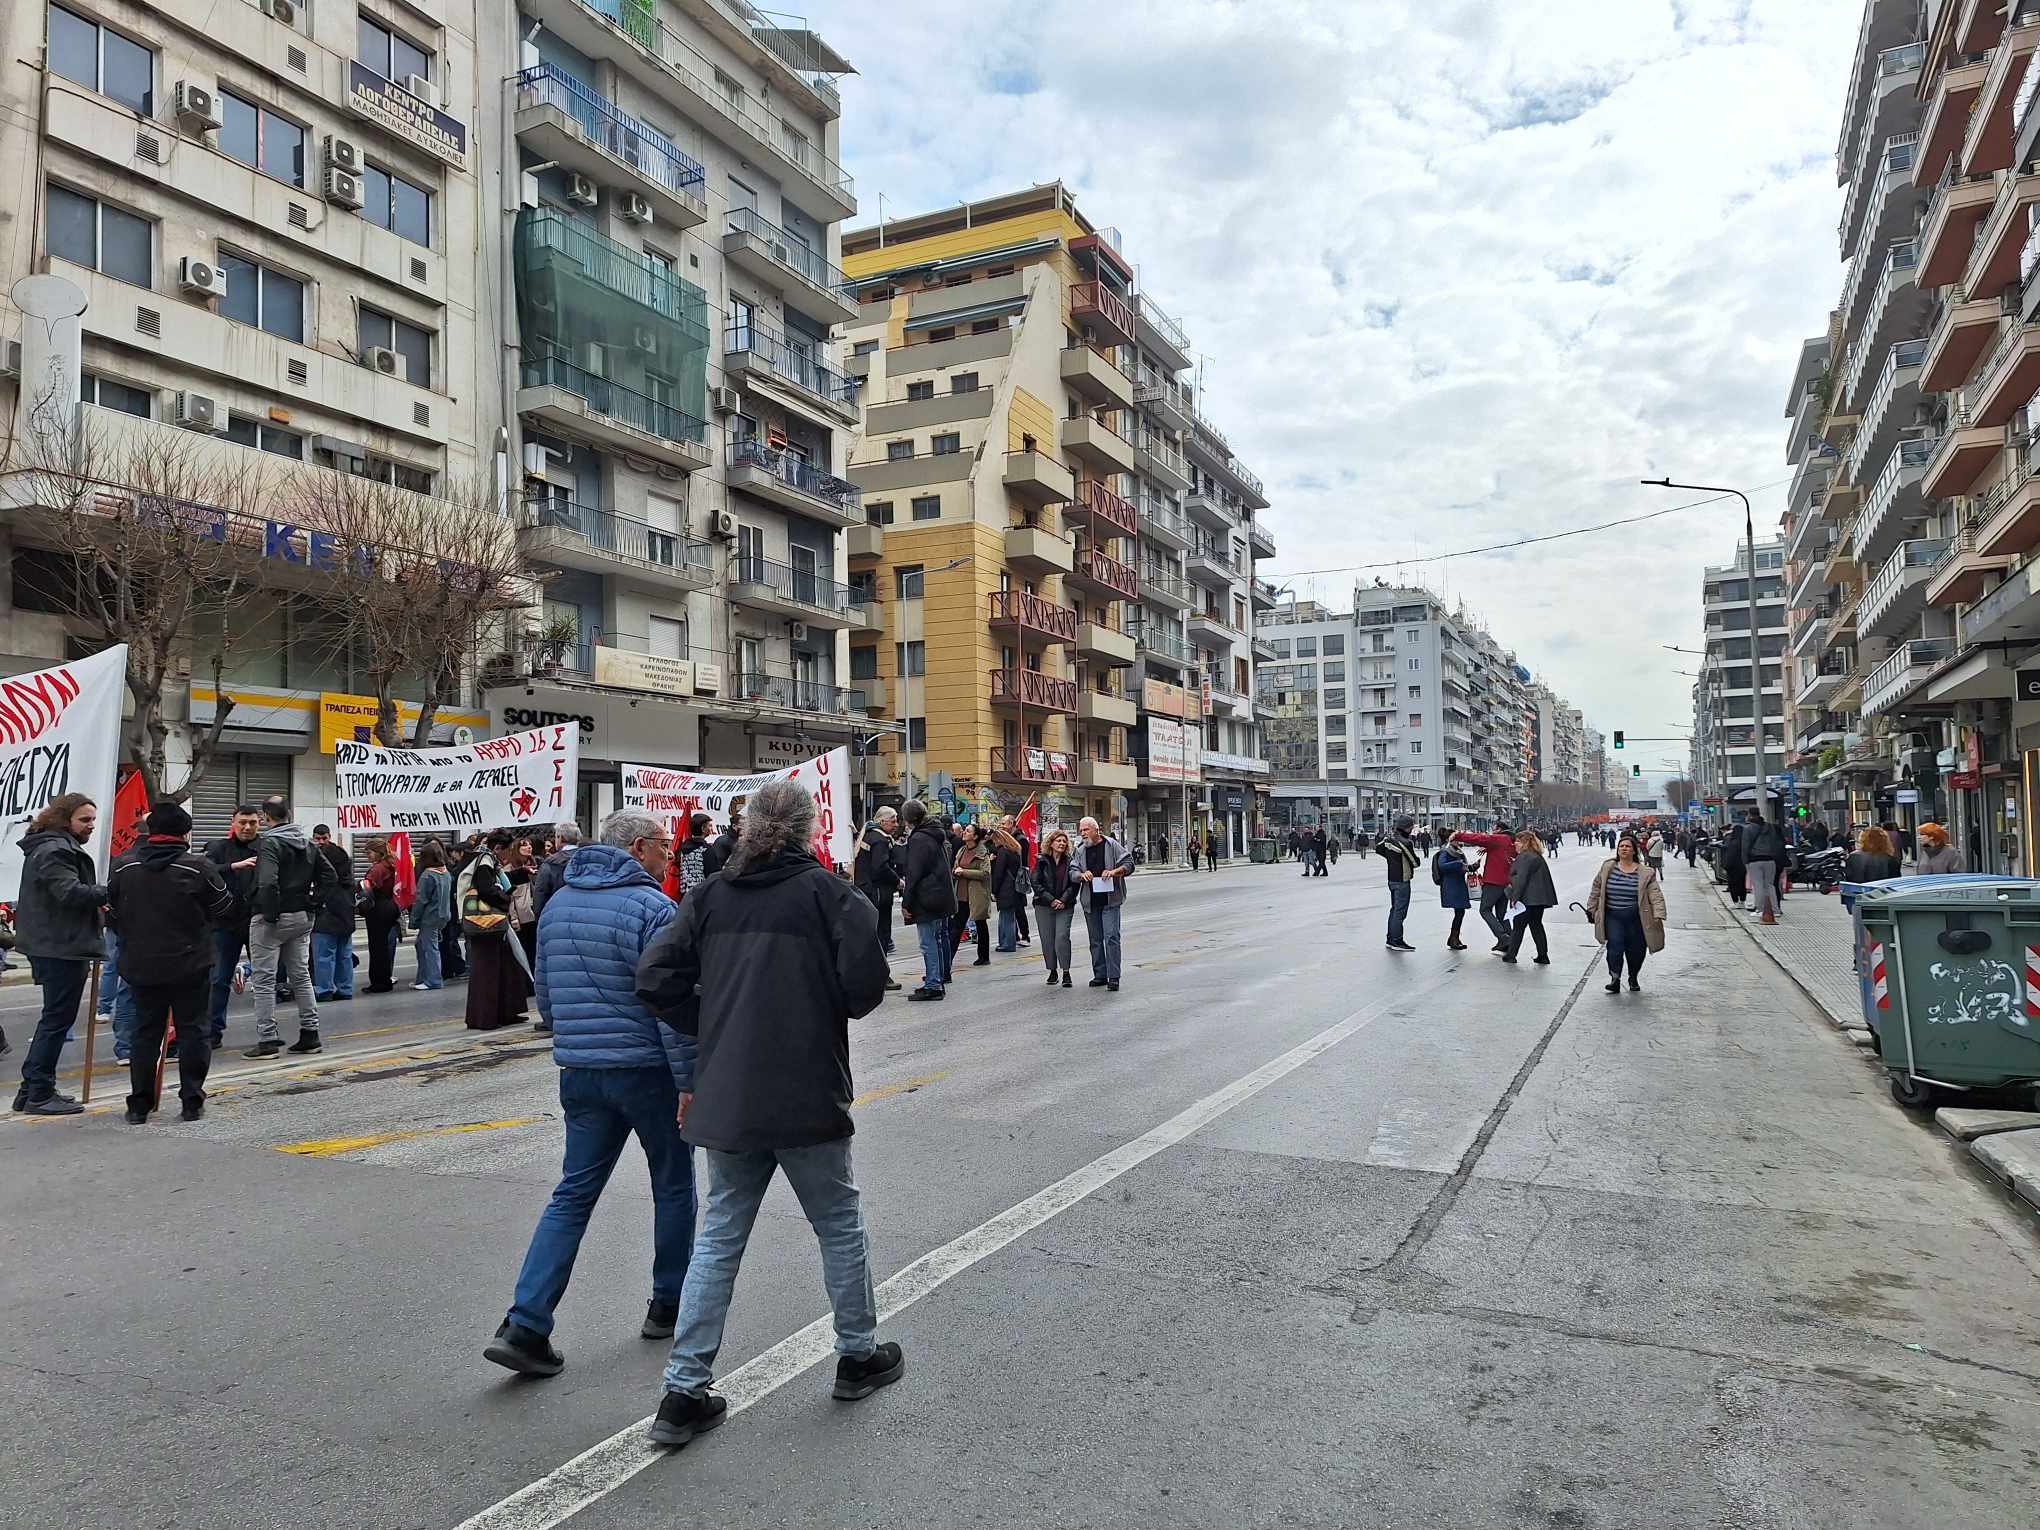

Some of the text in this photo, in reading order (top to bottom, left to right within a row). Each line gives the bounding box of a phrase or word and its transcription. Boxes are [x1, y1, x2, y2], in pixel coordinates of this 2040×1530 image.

[357, 83, 459, 150] ΛΟΓΟΘΕΡΑΠΕΙΑΣ
[384, 82, 434, 121] ΚΕΝΤΡΟ
[353, 97, 464, 164] ΜΑΘΗΣΙΑΚΕΣ ΔΥΣΚΟΛΙΕΣ
[325, 704, 362, 716] ΤΡΑΠΕΖΑ
[375, 753, 388, 765] ΤΑ
[389, 750, 427, 766] ΧΕΡΙΑ
[429, 758, 453, 767] ΑΠΟ
[456, 755, 472, 763] ΤΟ
[473, 737, 521, 760] ΑΡΘΡΟ
[529, 730, 546, 753] 16
[336, 765, 519, 799] Η ΤΡΟΜΟΚΡΑΤΙΑ ΔΕ ΘΑ ΠΕΡΑΣΕΙ
[625, 774, 637, 788] ΝΑ
[637, 770, 696, 790] ΣΠΑΣΟΥΜΕ
[390, 812, 423, 827] ΜΕΧΡΙ
[424, 812, 440, 826] ΤΗ
[442, 800, 482, 825] ΝΙΚΗ
[625, 796, 644, 806] ΤΗΣ
